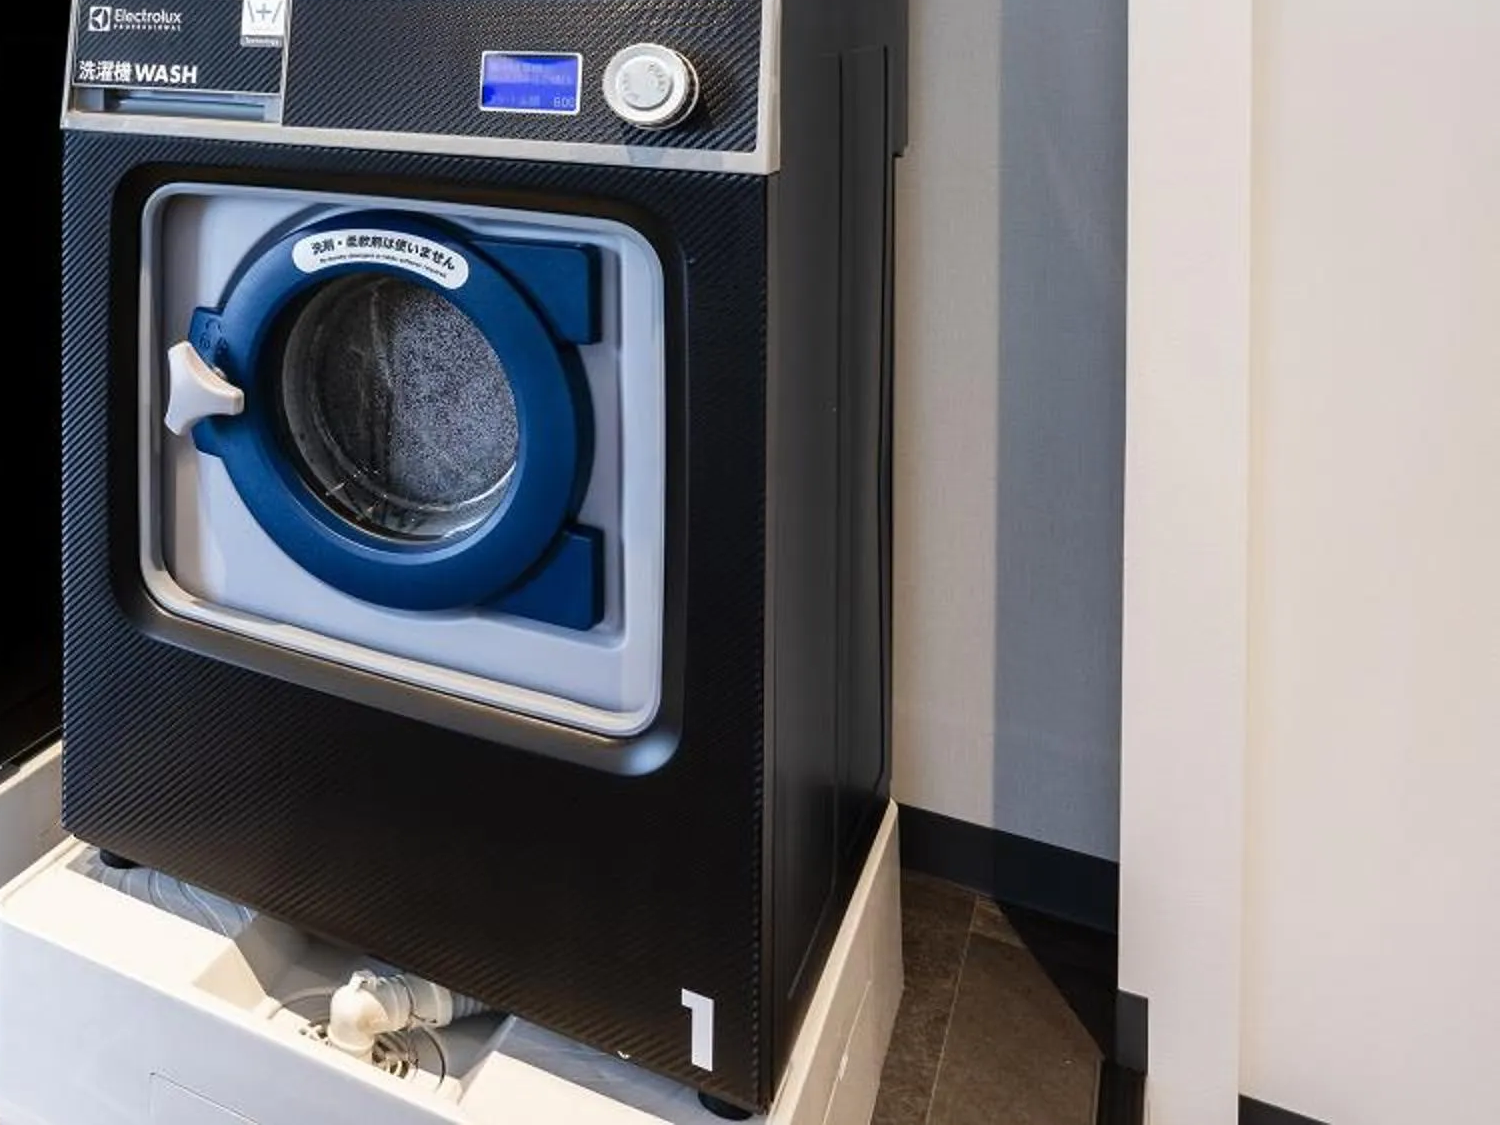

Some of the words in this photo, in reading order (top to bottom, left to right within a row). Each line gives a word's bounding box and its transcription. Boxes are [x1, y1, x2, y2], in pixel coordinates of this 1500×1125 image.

[114, 8, 182, 24] Electrolux
[78, 60, 132, 82] 洗濯機
[134, 63, 198, 84] WASH
[682, 988, 714, 1072] 1
